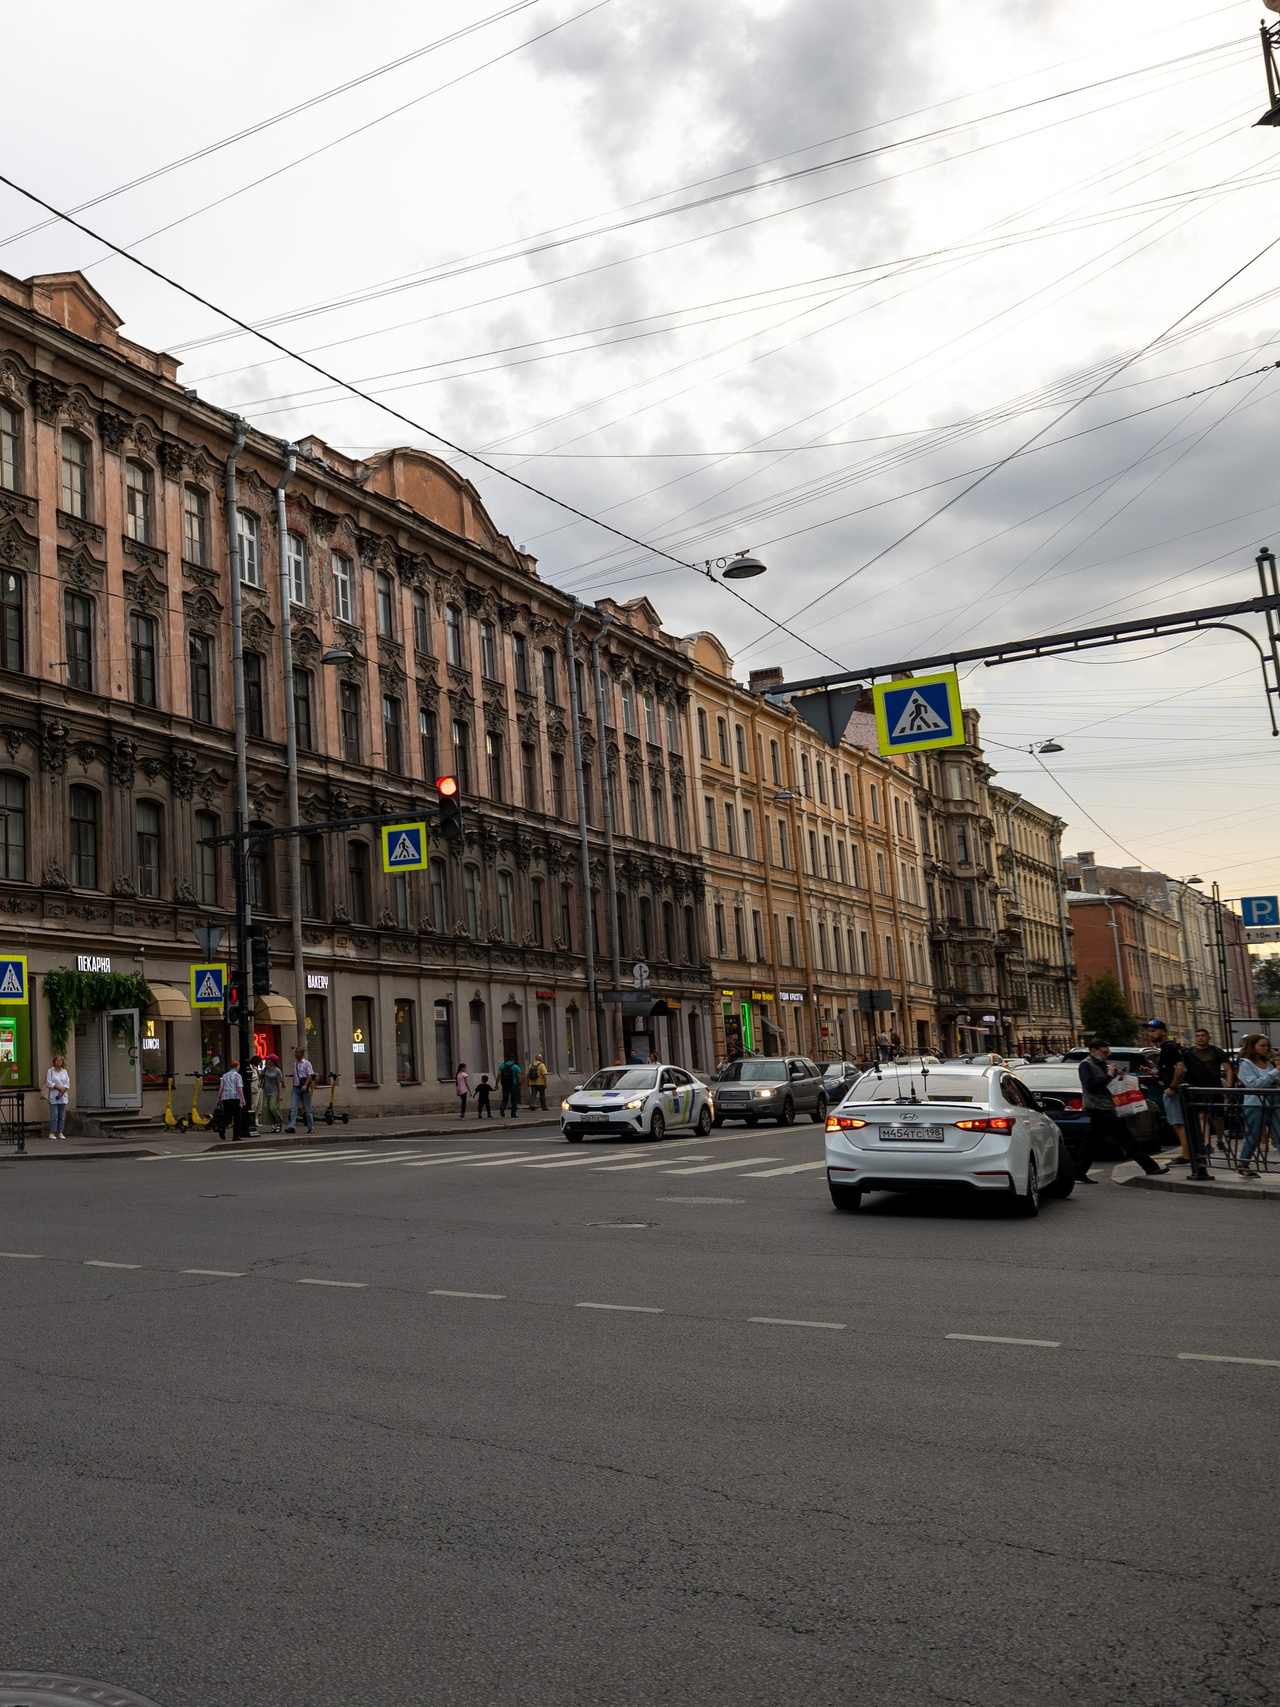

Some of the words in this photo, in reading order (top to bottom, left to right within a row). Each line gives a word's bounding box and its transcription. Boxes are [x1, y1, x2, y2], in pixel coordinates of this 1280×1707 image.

[1251, 899, 1273, 923] P
[77, 955, 111, 973] ПЕКАРНЯ
[307, 975, 329, 989] BAKERY
[143, 1038, 160, 1049] LUNCH
[882, 1128, 922, 1138] М454ТС
[924, 1128, 940, 1136] 198
